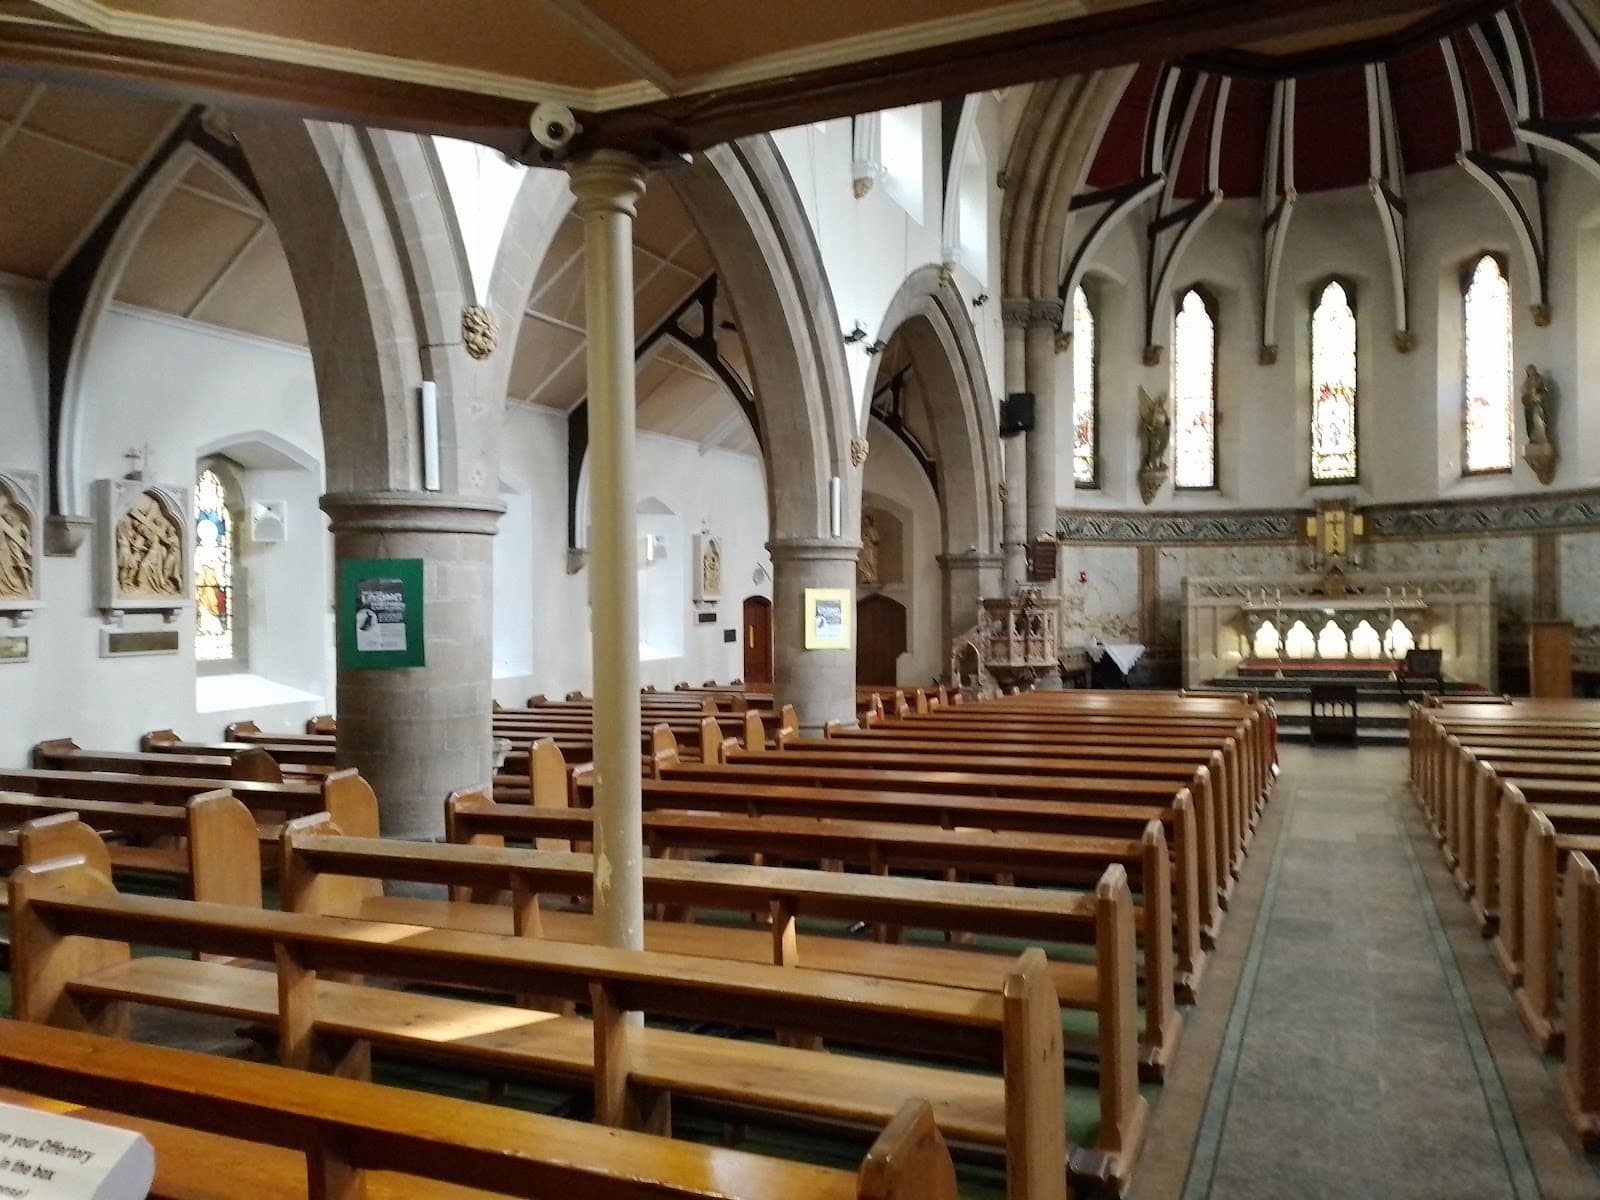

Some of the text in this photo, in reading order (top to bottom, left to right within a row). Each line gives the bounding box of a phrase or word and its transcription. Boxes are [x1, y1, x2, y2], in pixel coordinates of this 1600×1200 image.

[8, 1136, 39, 1148] your
[40, 1139, 95, 1164] Offertory
[11, 1160, 31, 1175] the
[32, 1163, 56, 1181] box
